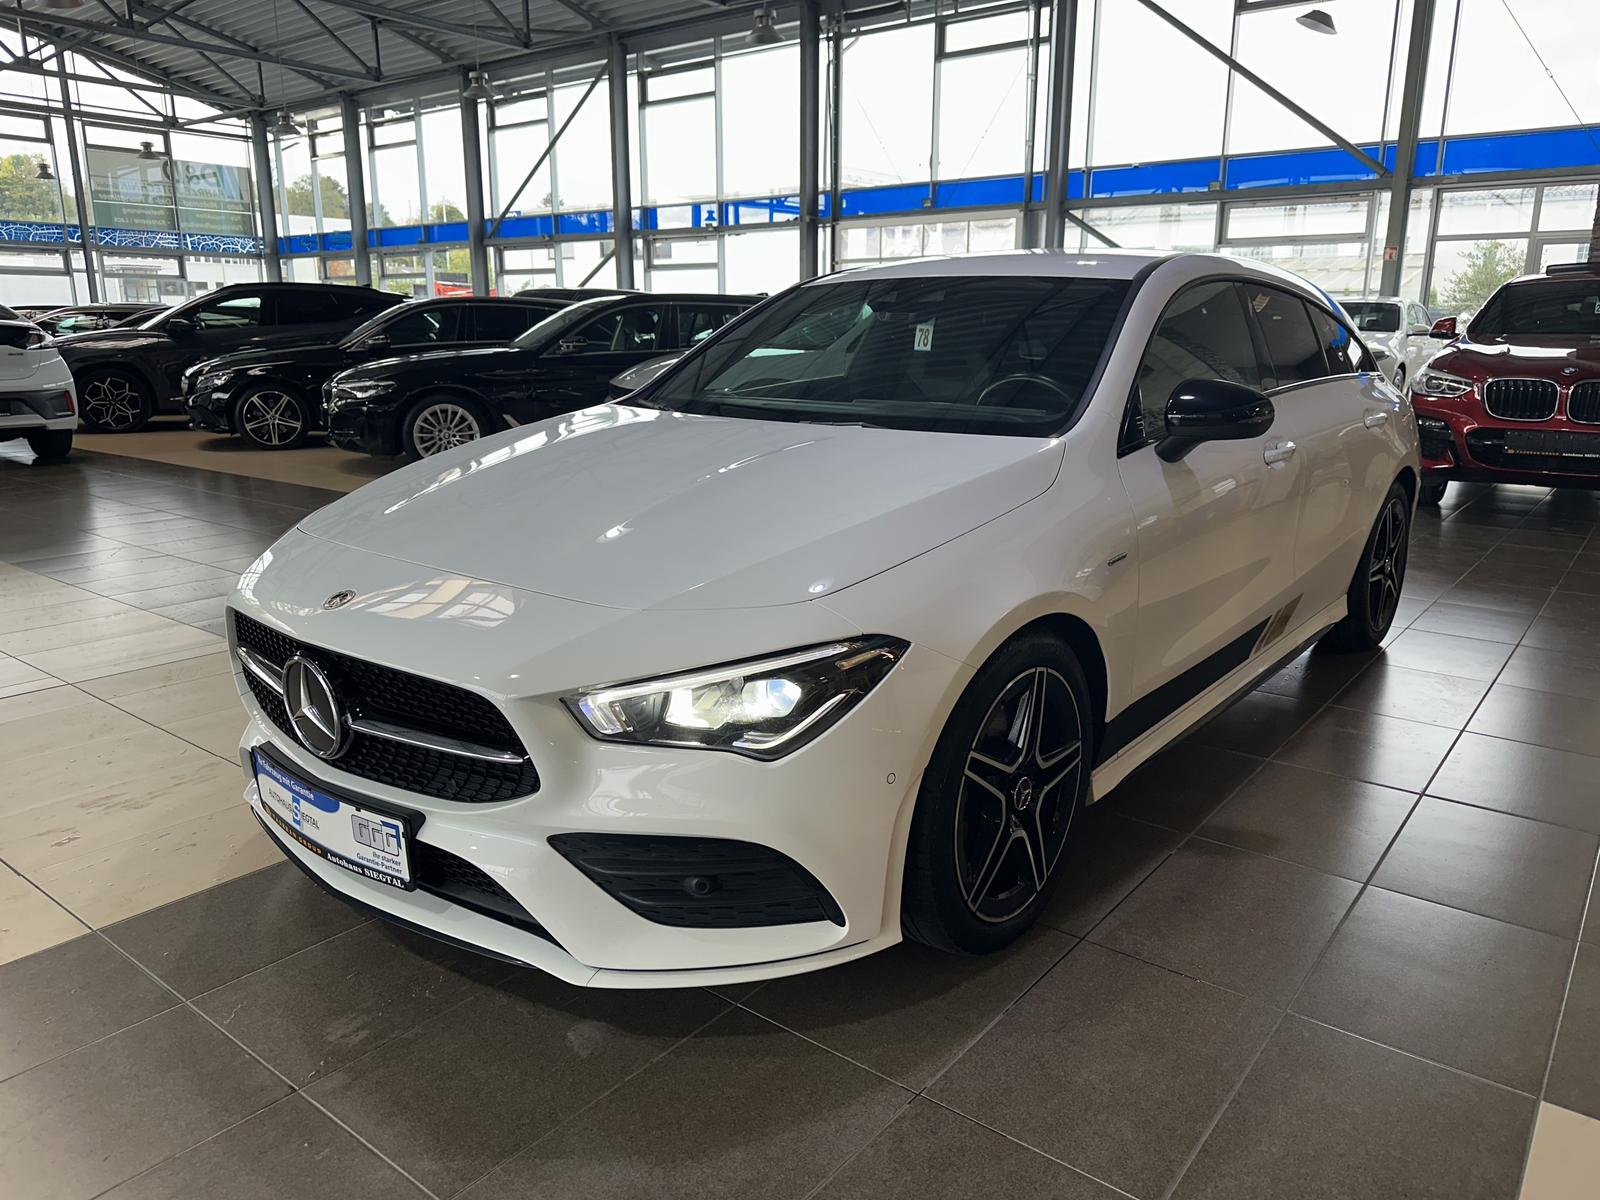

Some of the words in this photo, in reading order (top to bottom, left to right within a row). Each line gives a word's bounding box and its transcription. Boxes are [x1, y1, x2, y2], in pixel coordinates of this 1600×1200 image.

[917, 328, 930, 348] 78
[290, 780, 315, 801] Garantie
[326, 852, 363, 875] Autohaus
[364, 868, 405, 889] SIEGTAL
[356, 852, 403, 875] Garantie-Partner
[381, 854, 402, 867] starker
